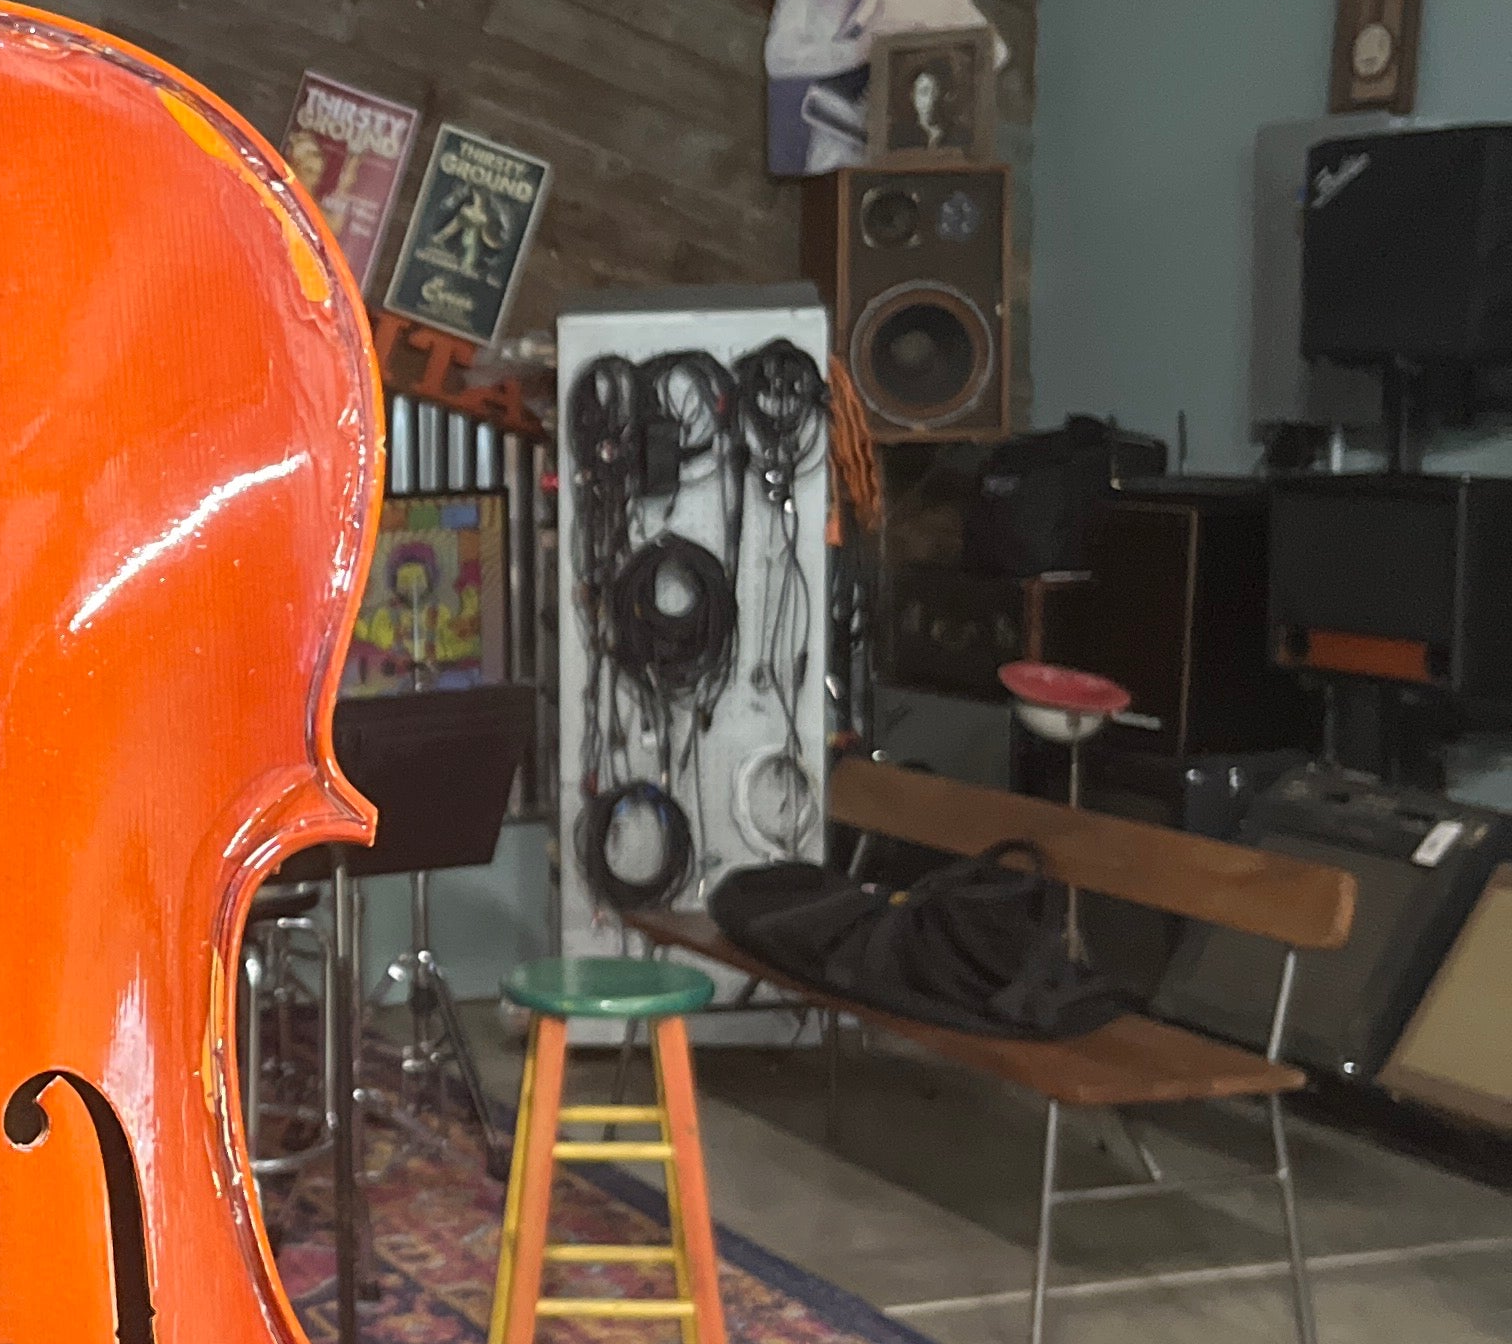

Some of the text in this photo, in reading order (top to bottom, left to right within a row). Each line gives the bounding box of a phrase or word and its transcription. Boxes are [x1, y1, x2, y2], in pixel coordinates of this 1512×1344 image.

[297, 106, 400, 159] GROUND
[306, 86, 408, 141] THIRSTY
[440, 152, 534, 203] GROUND
[459, 140, 528, 178] THIRSTY
